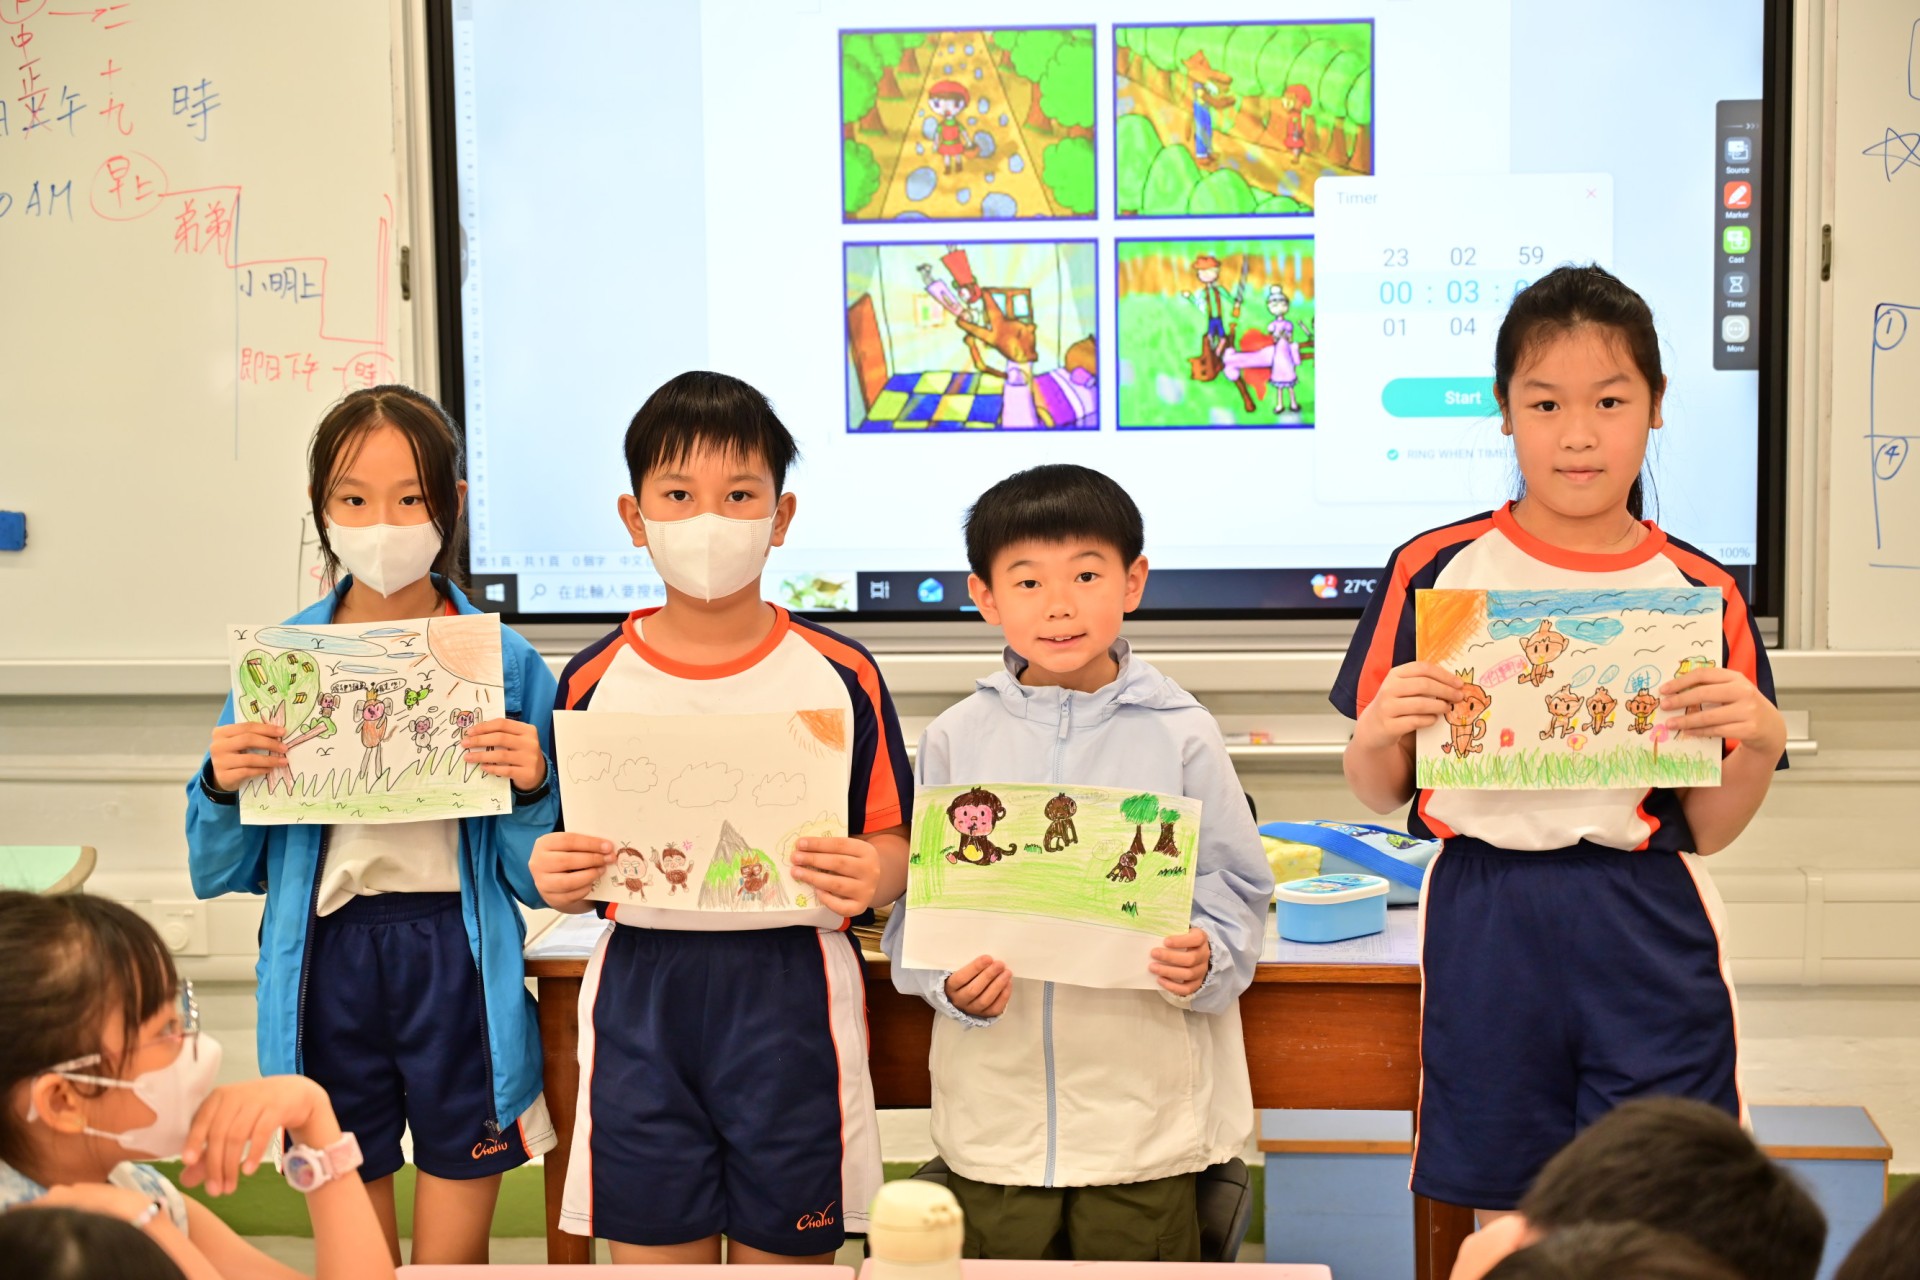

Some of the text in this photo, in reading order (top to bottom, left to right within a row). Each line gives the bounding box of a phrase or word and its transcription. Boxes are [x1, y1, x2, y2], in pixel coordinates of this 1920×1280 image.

[172, 78, 221, 142] 時
[1725, 166, 1750, 174] Source
[106, 155, 155, 209] 早上
[26, 180, 74, 222] AM
[1337, 191, 1378, 205] Timer
[1725, 211, 1750, 219] Marker
[174, 198, 231, 254] 弟弟
[1383, 246, 1544, 267] 23 02 59
[1728, 256, 1745, 264] Cast
[1726, 300, 1747, 308] Timer
[1383, 317, 1477, 337] 01 04
[1726, 345, 1745, 353] More
[1444, 390, 1482, 405] Start
[1407, 449, 1435, 459] RING
[1439, 449, 1474, 459] WHEN
[1719, 546, 1751, 559] 100%
